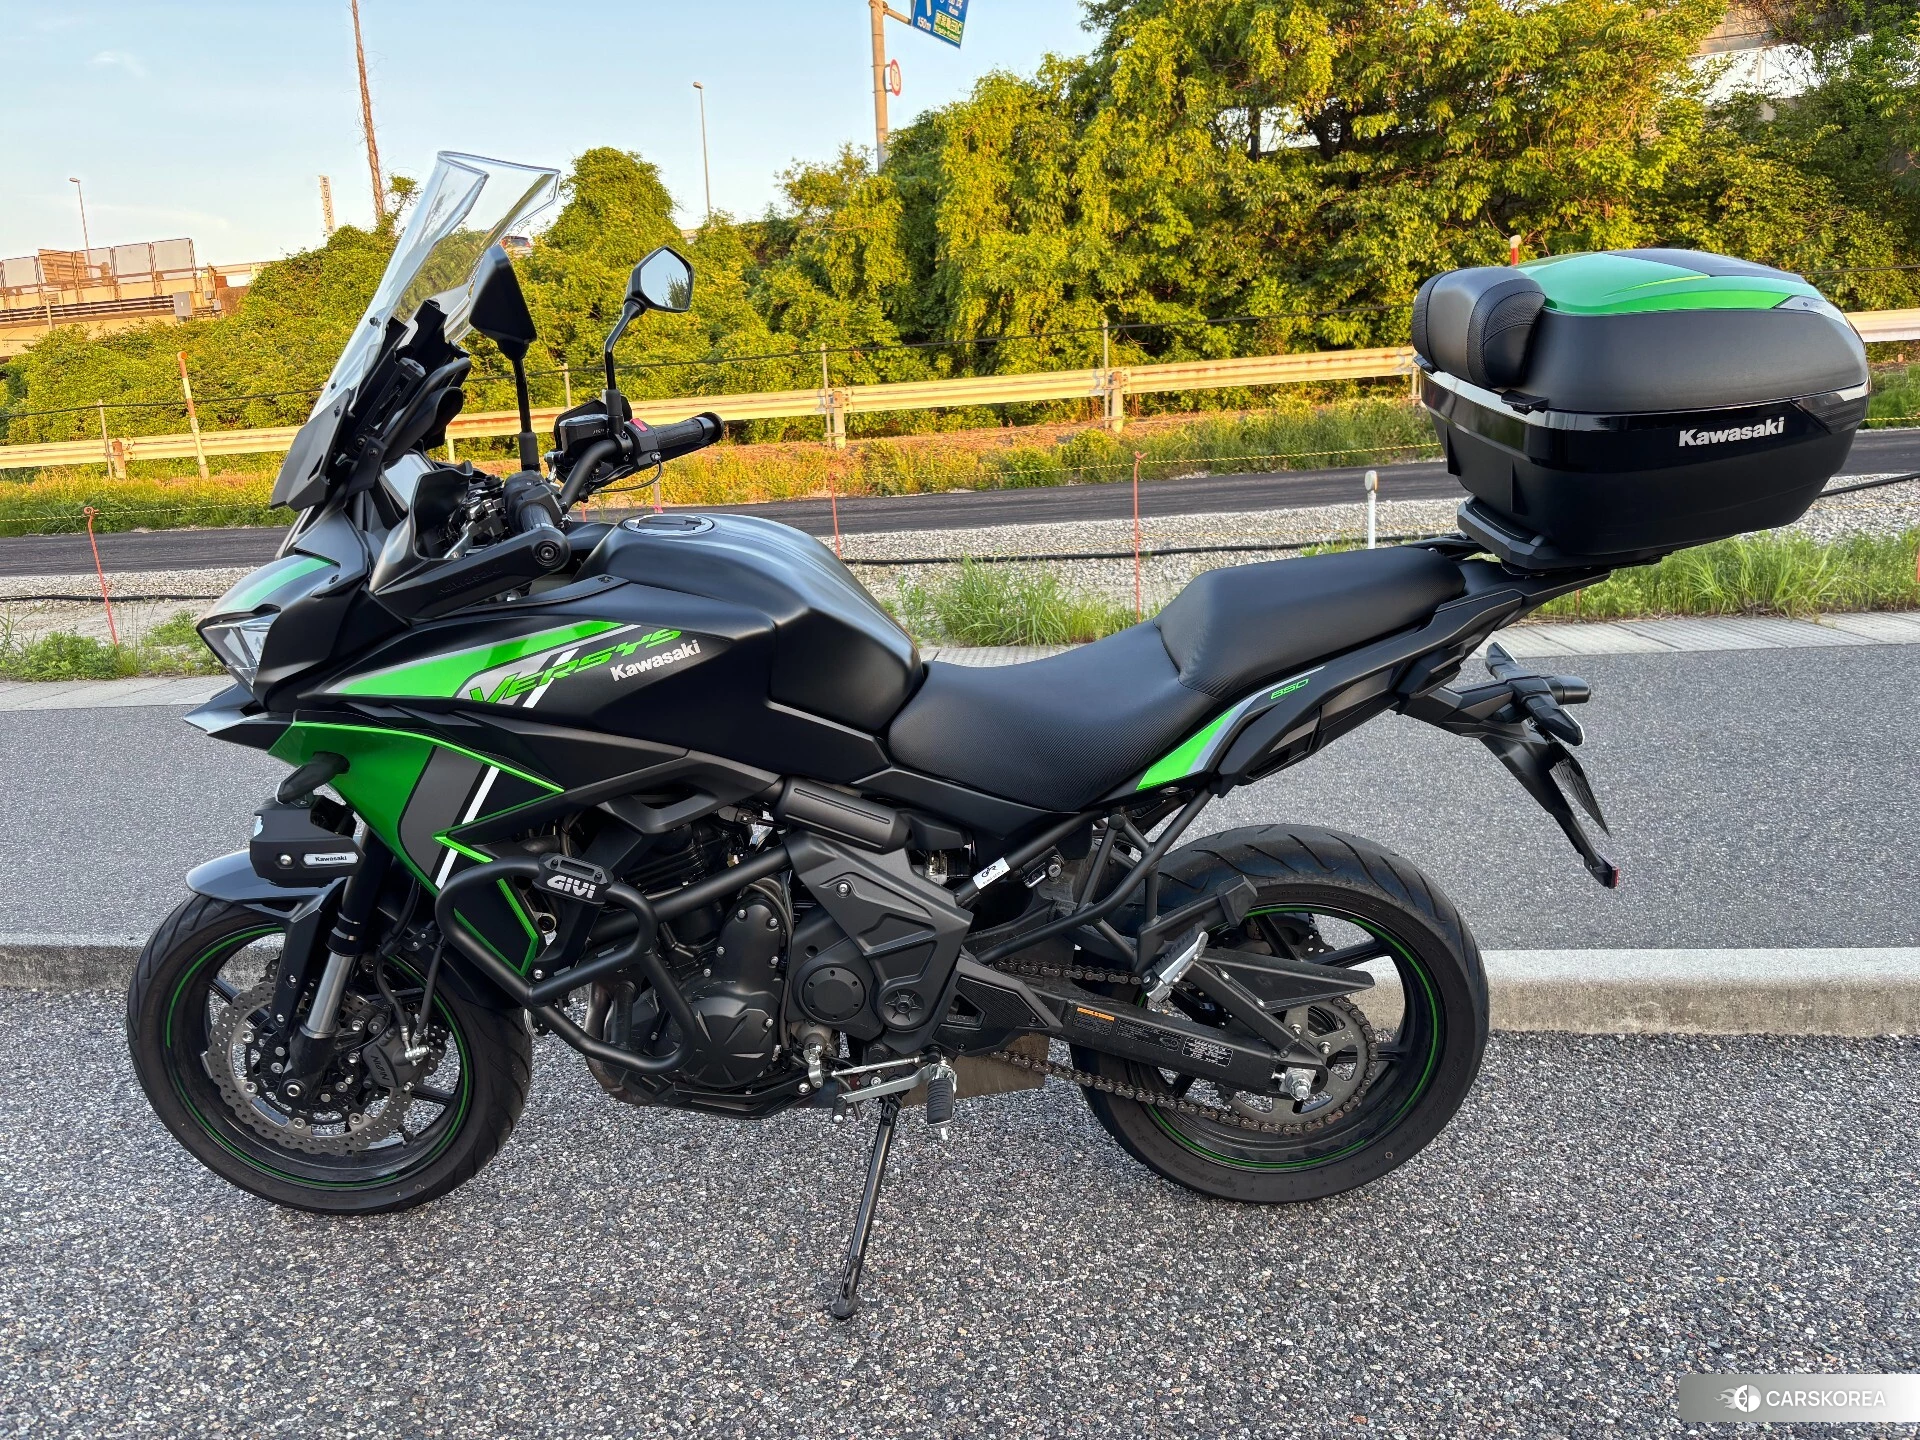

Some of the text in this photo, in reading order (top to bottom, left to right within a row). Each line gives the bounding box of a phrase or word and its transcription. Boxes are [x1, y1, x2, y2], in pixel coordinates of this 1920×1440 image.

[1678, 417, 1785, 447] Kawasaki
[469, 628, 682, 704] VERSYS
[609, 639, 701, 682] Kawasaki
[1270, 678, 1309, 700] 650
[546, 874, 597, 899] GIVI
